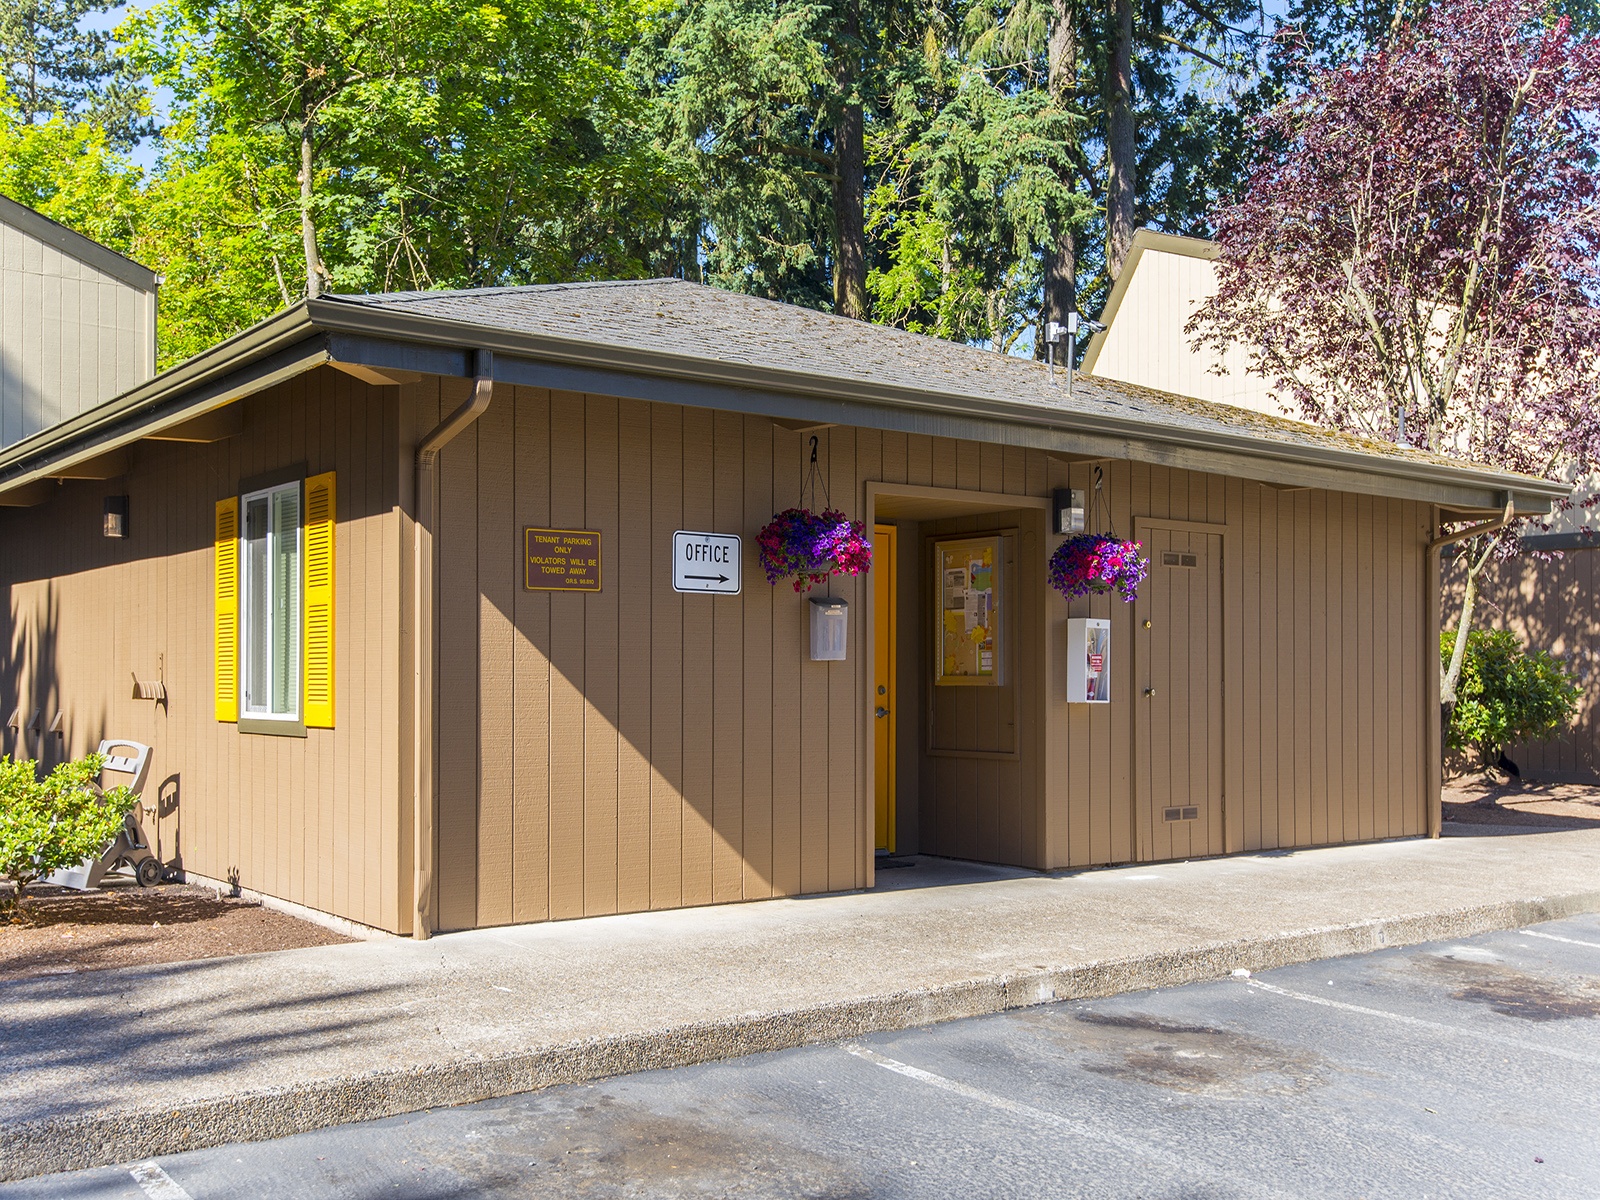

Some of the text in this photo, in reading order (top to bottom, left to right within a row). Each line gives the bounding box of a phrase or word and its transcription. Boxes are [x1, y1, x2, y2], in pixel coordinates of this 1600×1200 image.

[534, 536, 592, 546] TENANT PARKING
[686, 543, 730, 563] OFFICE
[530, 556, 566, 565] VIOLATORS
[541, 566, 566, 574] TOWED
